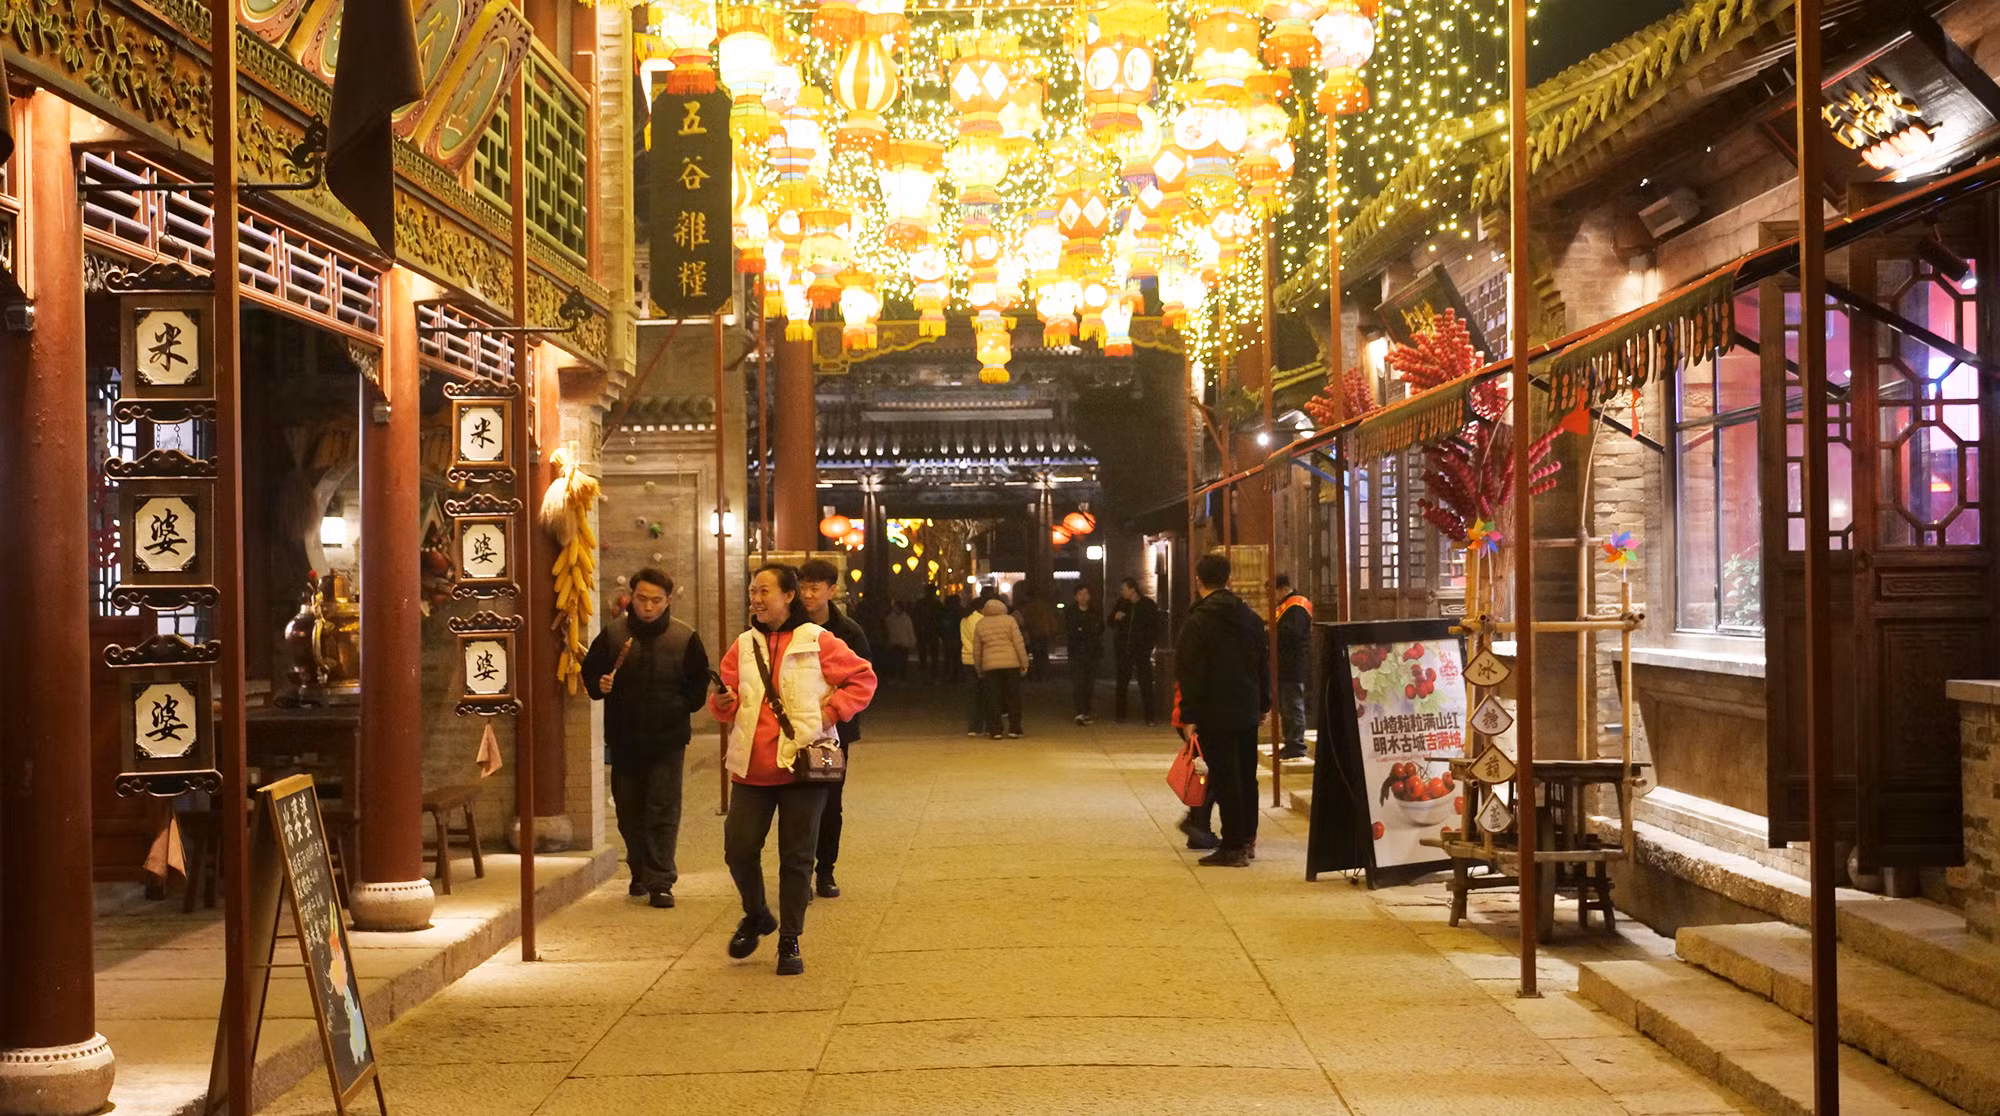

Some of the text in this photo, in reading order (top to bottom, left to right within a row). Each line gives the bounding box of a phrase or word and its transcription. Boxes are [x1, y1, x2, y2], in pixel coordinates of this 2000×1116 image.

[147, 322, 188, 372] 米
[470, 417, 495, 448] 米
[144, 508, 187, 555] 婆
[470, 533, 497, 564] 婆
[473, 650, 499, 681] 婆
[1478, 659, 1497, 680] 冰
[146, 694, 188, 741] 婆
[1371, 712, 1460, 735] 山楂粒粒满山红
